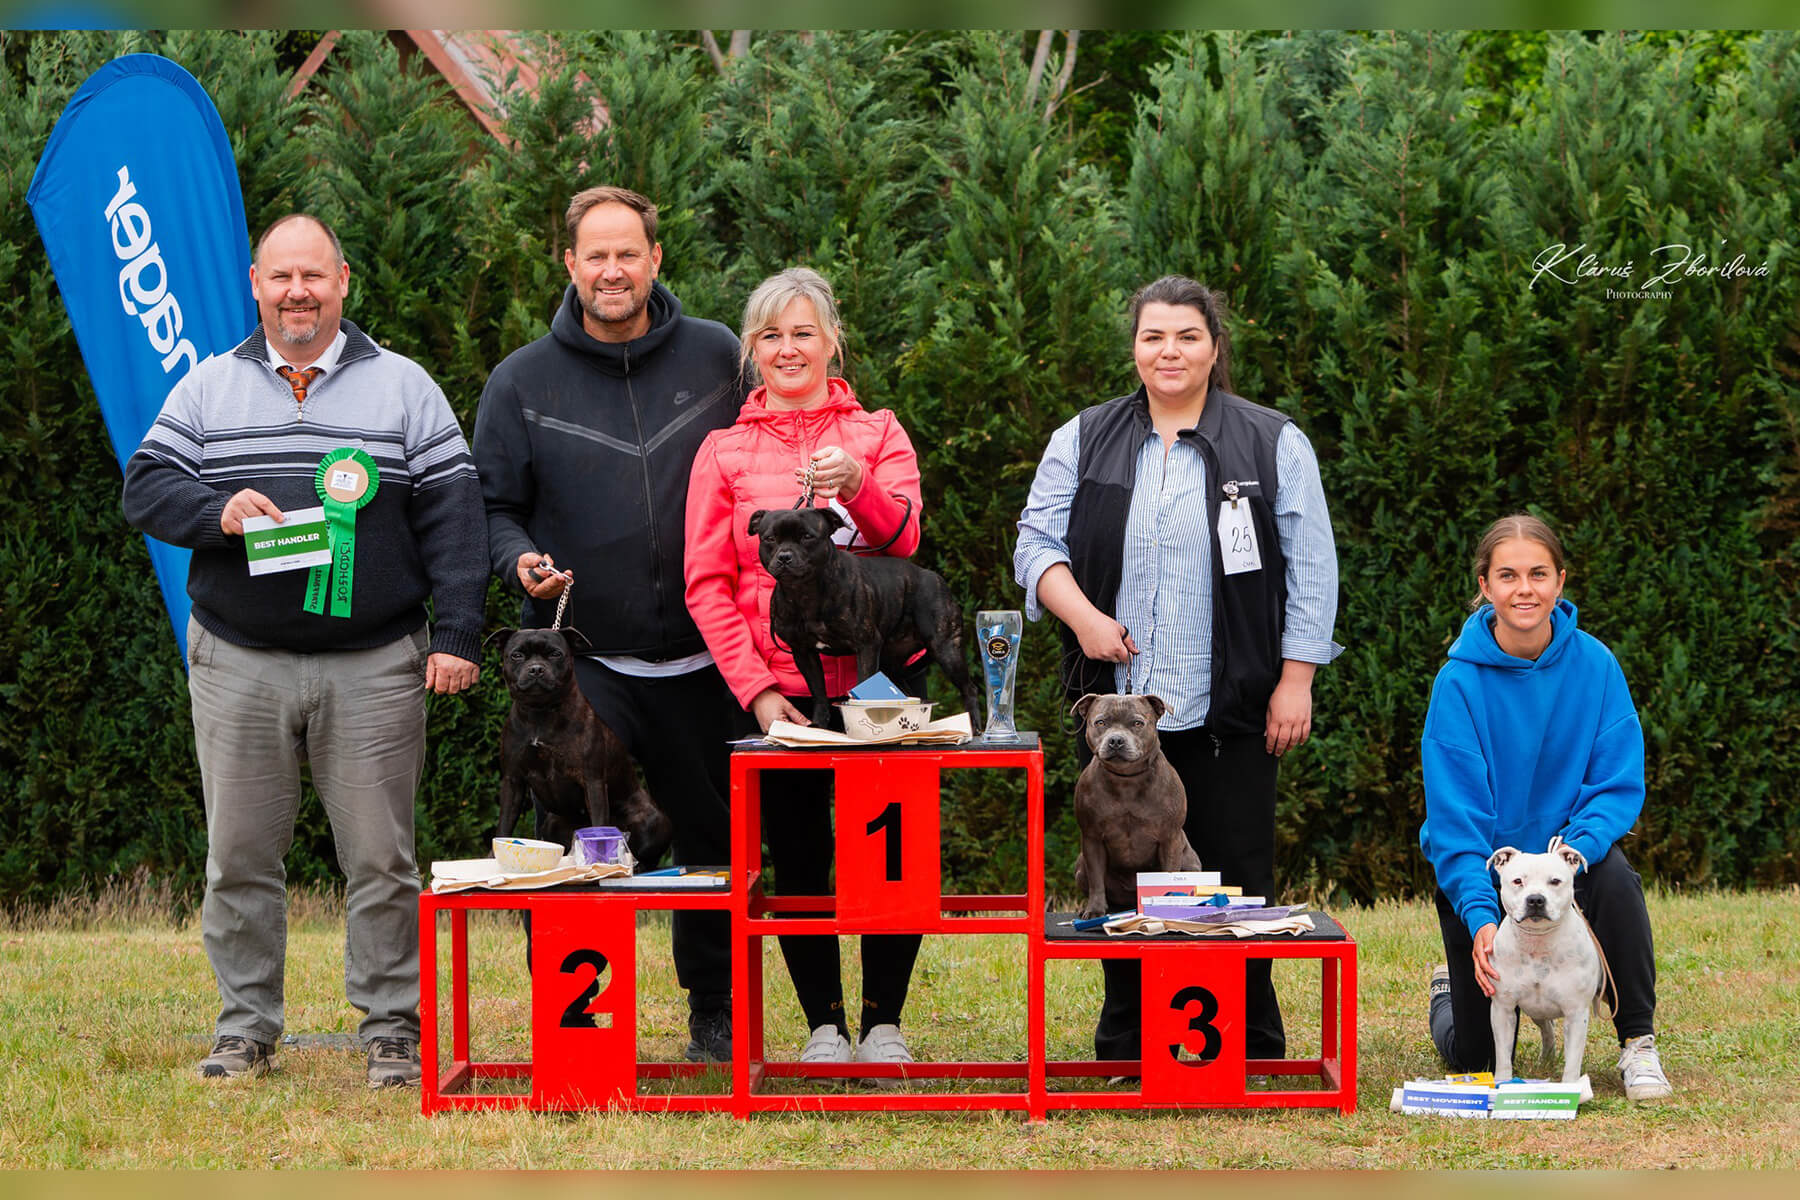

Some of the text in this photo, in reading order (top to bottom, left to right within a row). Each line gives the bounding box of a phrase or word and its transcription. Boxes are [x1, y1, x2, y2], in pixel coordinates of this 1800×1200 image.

[254, 533, 320, 550] BEST HANDLER
[1231, 526, 1253, 553] 25
[866, 802, 903, 881] 1
[560, 948, 613, 1028] 2
[1168, 986, 1222, 1068] 3
[1431, 1097, 1484, 1105] MOVEMENT
